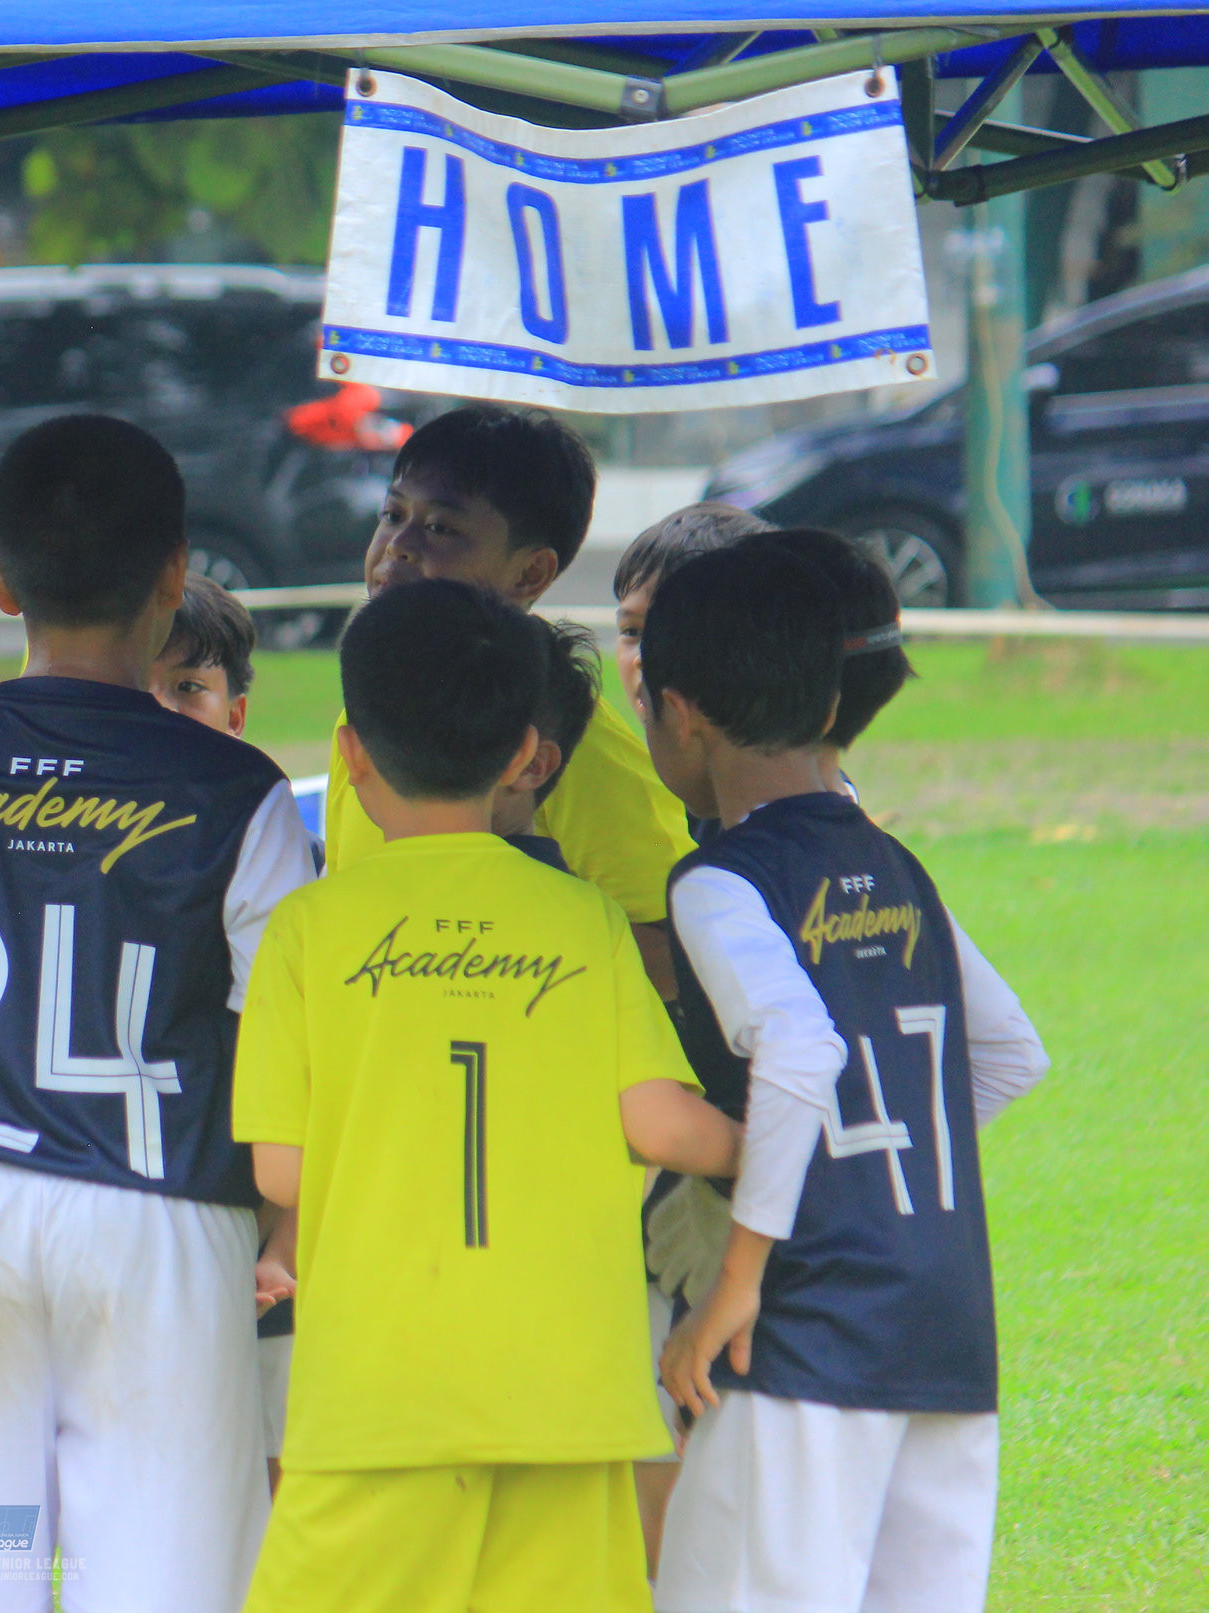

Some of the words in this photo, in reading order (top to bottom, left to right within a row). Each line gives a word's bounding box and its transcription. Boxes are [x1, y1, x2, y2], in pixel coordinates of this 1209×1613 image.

[386, 146, 842, 351] HOME
[10, 757, 84, 776] FFF
[7, 839, 75, 853] JAKARTA
[840, 874, 875, 894] FFF
[436, 919, 495, 934] FFF
[801, 877, 921, 970] Academy
[345, 916, 587, 1018] Academy
[443, 989, 495, 999] JAKARTA
[822, 1004, 954, 1215] 47
[450, 1040, 488, 1249] 1
